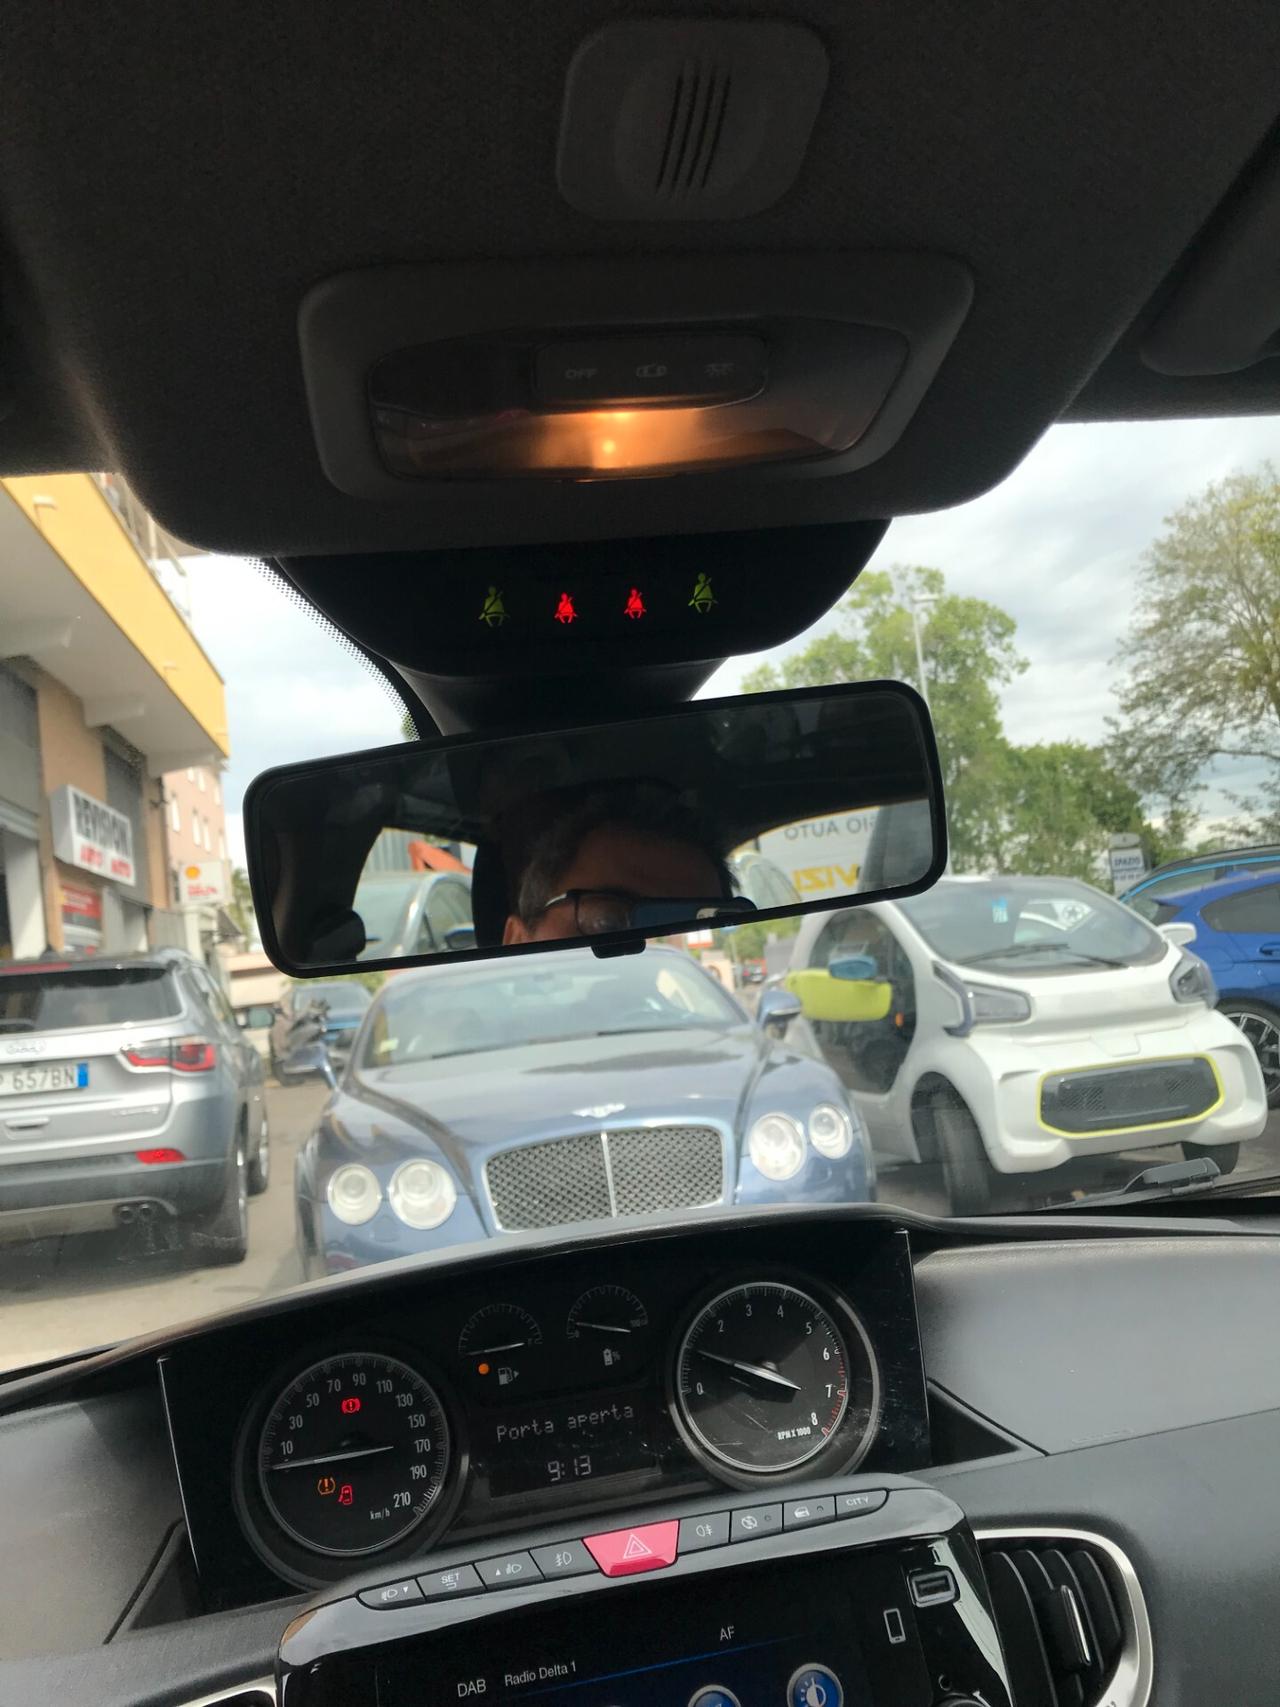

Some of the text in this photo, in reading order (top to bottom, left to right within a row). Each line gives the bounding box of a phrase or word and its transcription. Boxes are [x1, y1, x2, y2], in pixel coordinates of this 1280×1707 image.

[565, 367, 598, 379] OFF
[745, 1304, 753, 1317] 3
[777, 1305, 784, 1318] 4
[718, 1319, 725, 1333] 2
[805, 1321, 813, 1335] 5
[822, 1347, 830, 1361] 6
[327, 1378, 342, 1393] 70
[352, 1372, 367, 1387] 90
[376, 1379, 393, 1394] 110
[825, 1383, 833, 1398] 7
[306, 1392, 320, 1408] 50
[395, 1392, 414, 1408] 130
[289, 1414, 303, 1430] 30
[408, 1414, 426, 1430] 150
[497, 1404, 634, 1443] Porta aperta
[810, 1411, 818, 1426] 8
[777, 1429, 791, 1441] RPM
[796, 1426, 811, 1437] 1000
[281, 1440, 294, 1455] 10
[414, 1438, 431, 1453] 170
[410, 1464, 427, 1480] 190
[547, 1455, 593, 1482] 9:13
[393, 1491, 412, 1509] 210
[845, 1495, 870, 1507] CITY
[369, 1508, 391, 1521] km/h
[441, 1571, 460, 1584] SET
[719, 1626, 736, 1642] AF
[504, 1659, 577, 1687] Radio Delta 1
[456, 1678, 487, 1698] DAB
